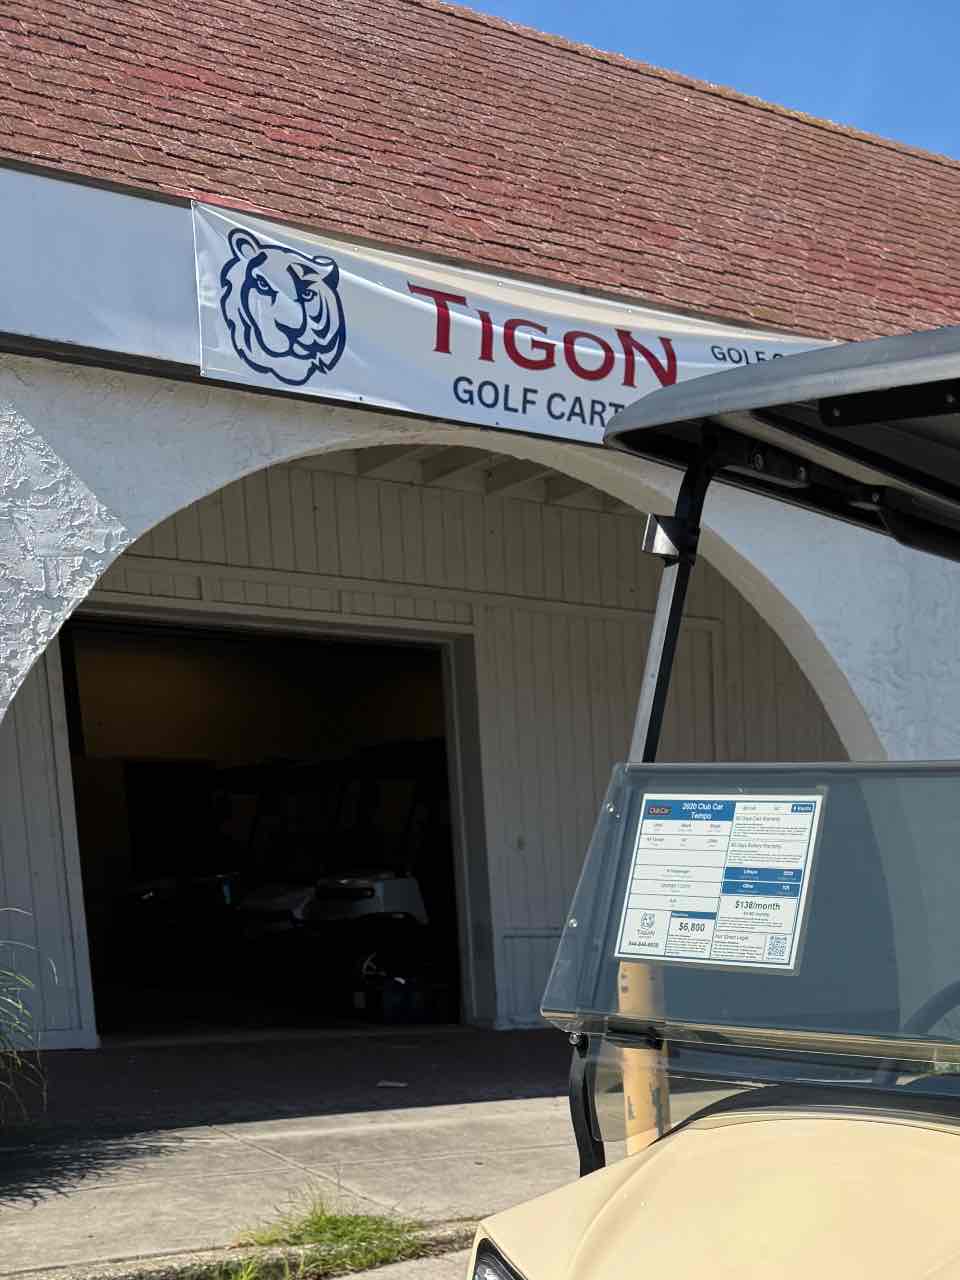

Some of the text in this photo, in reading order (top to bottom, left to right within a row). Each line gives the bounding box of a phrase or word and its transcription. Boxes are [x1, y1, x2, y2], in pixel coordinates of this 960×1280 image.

[407, 281, 678, 389] TIGON
[453, 376, 539, 415] GOLF
[698, 802, 712, 810] Club
[712, 803, 724, 811] Car
